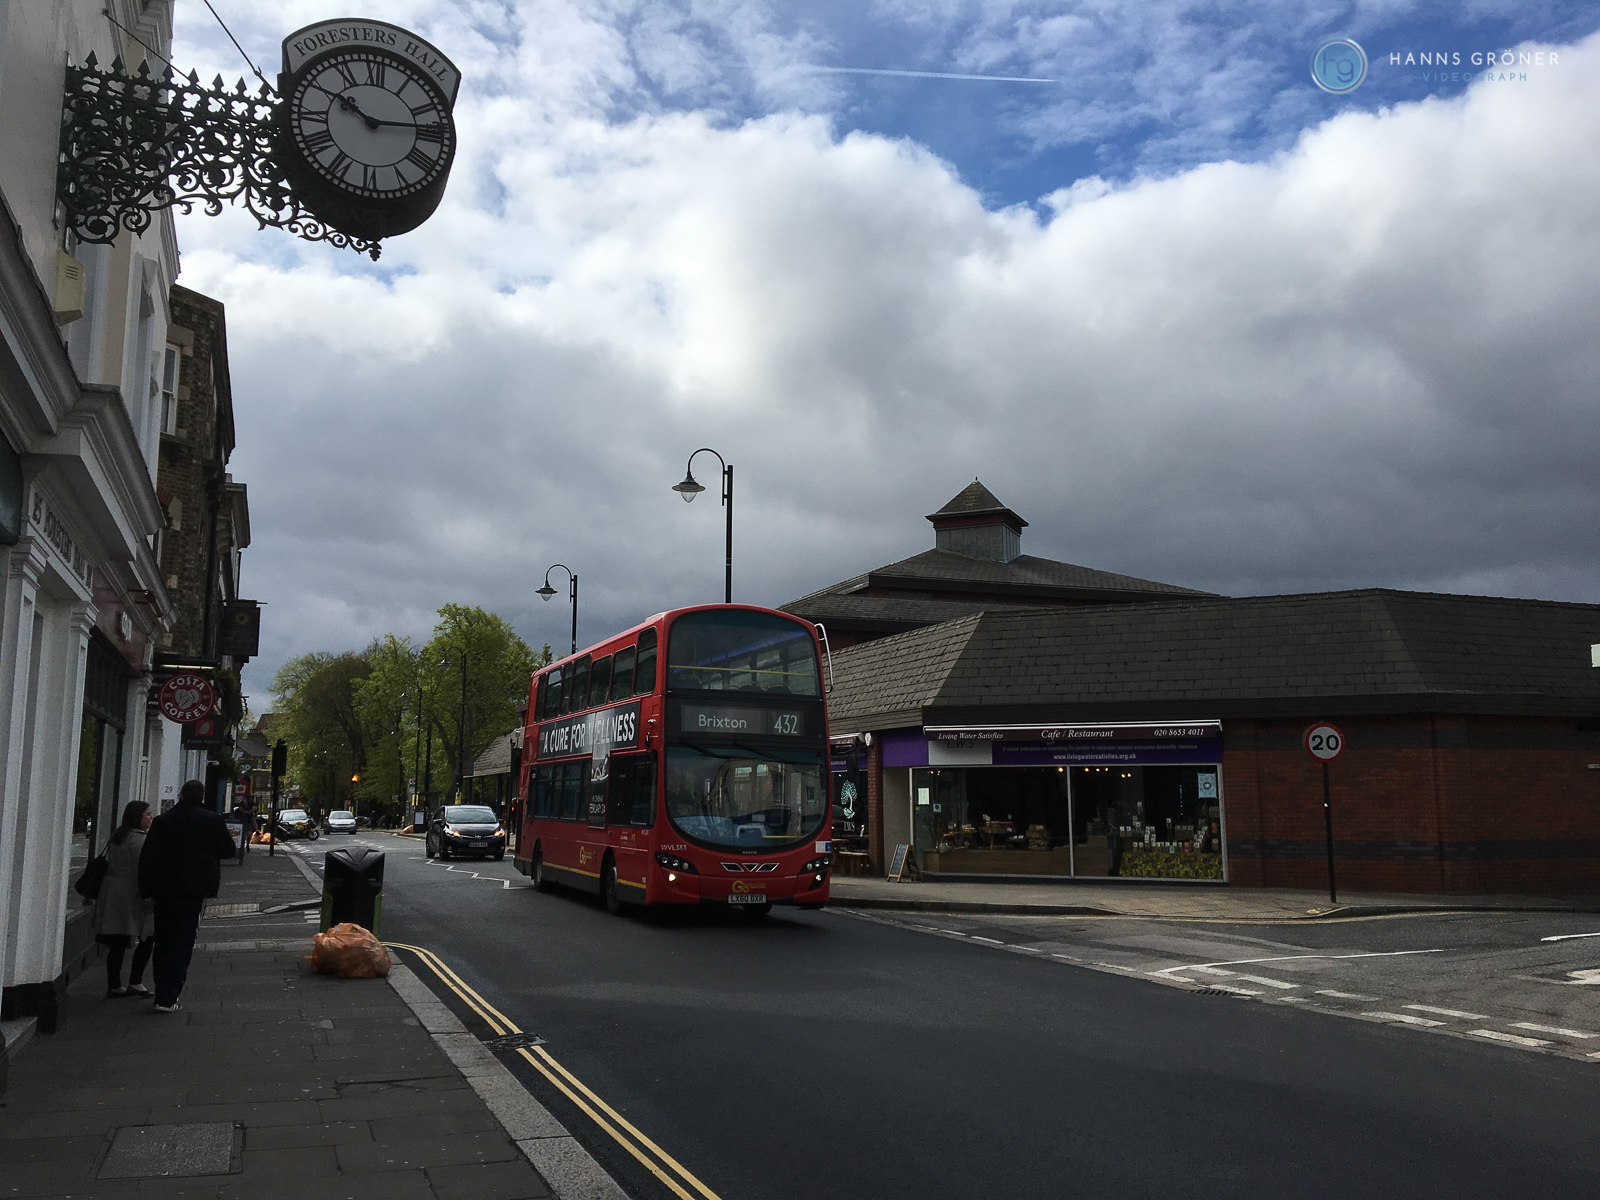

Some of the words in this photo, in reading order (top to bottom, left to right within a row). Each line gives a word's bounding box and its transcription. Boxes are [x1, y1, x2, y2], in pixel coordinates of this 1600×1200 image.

[292, 27, 397, 57] FORESTERS
[402, 40, 449, 81] HALL
[168, 676, 205, 691] COSTA
[164, 702, 208, 720] COFFEE
[698, 714, 747, 729] Brixton
[774, 714, 798, 734] 432
[542, 730, 549, 754] A
[550, 726, 570, 753] CURE
[570, 722, 586, 753] FOR
[588, 712, 636, 746] WELLNESS
[938, 732, 958, 740] Living
[978, 732, 1004, 740] Satisfies
[1041, 730, 1061, 740] Cafe
[1068, 730, 1114, 738] Restaurant
[1312, 734, 1340, 750] 20
[843, 822, 856, 832] LWS
[750, 894, 764, 903] DXR
